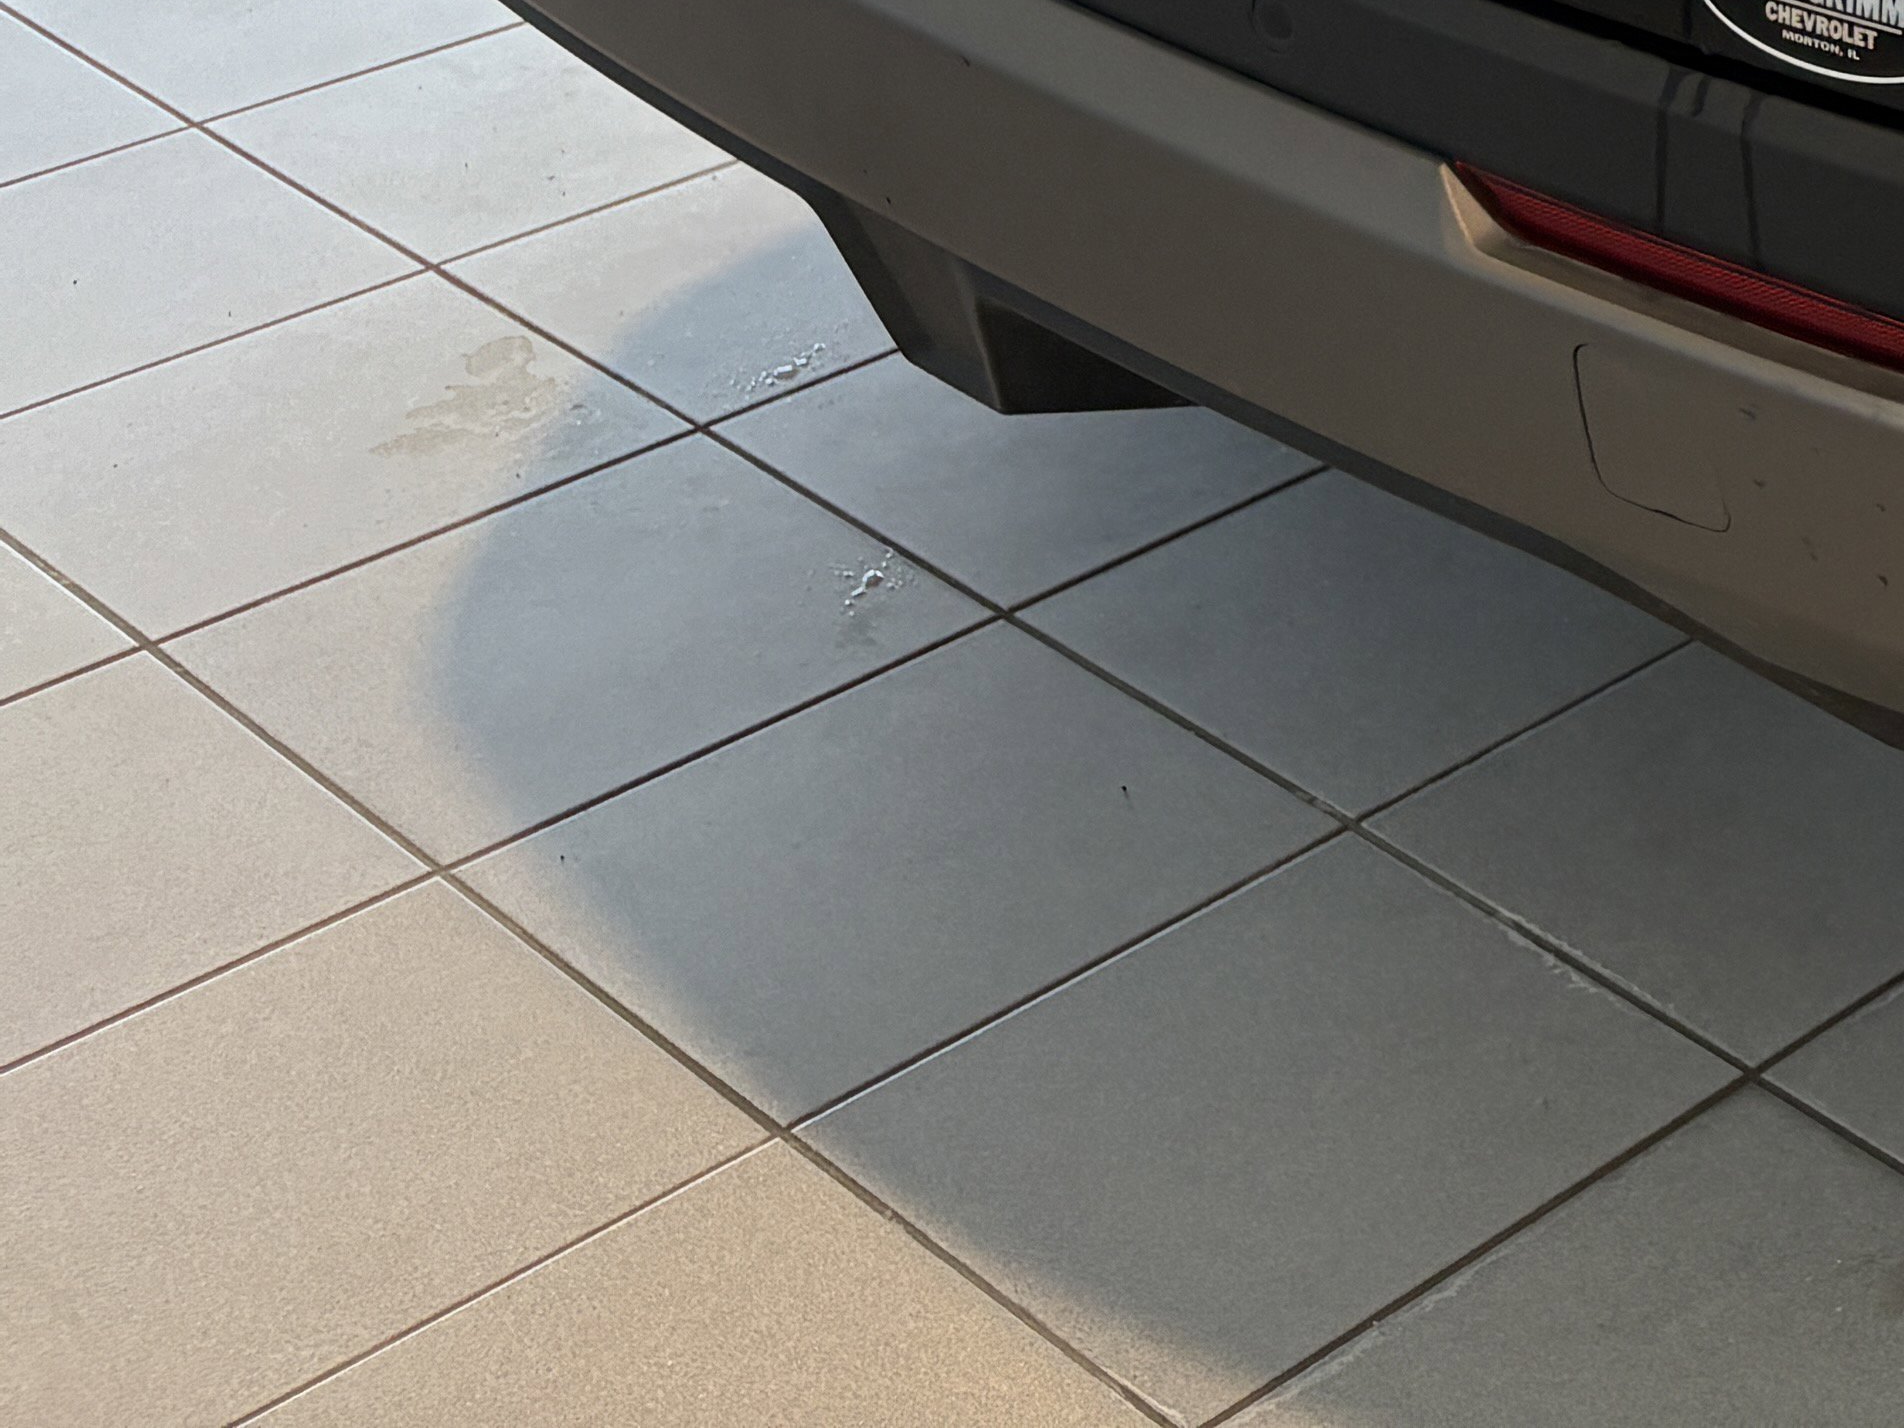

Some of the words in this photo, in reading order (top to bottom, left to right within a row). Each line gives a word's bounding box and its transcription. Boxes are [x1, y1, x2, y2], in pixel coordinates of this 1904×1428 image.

[1765, 0, 1878, 50] CHEVROLET
[1782, 29, 1844, 56] MORTON,
[1847, 48, 1860, 61] IL
